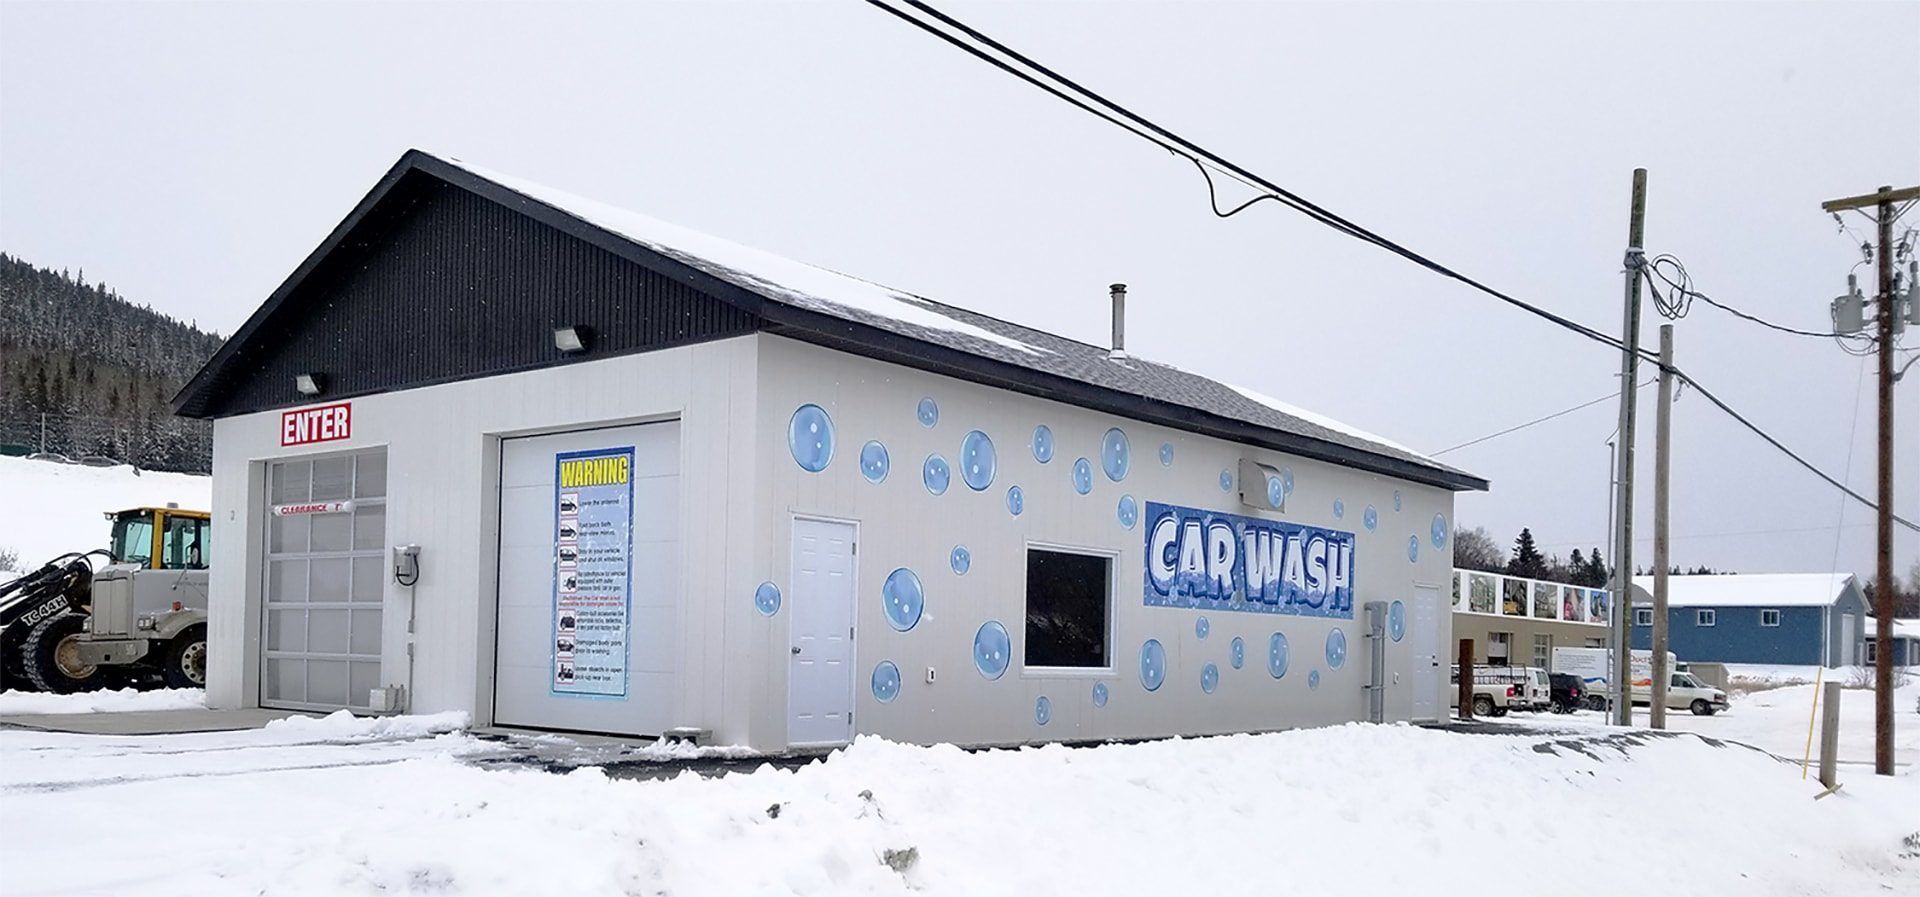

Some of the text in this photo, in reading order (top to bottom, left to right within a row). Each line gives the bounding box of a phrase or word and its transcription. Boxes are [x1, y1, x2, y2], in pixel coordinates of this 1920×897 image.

[283, 406, 348, 444] ENTER
[561, 455, 628, 488] WARNING
[281, 503, 328, 515] CLEARANCE
[1149, 512, 1351, 610] CAR WASH
[21, 594, 69, 626] TC 44H
